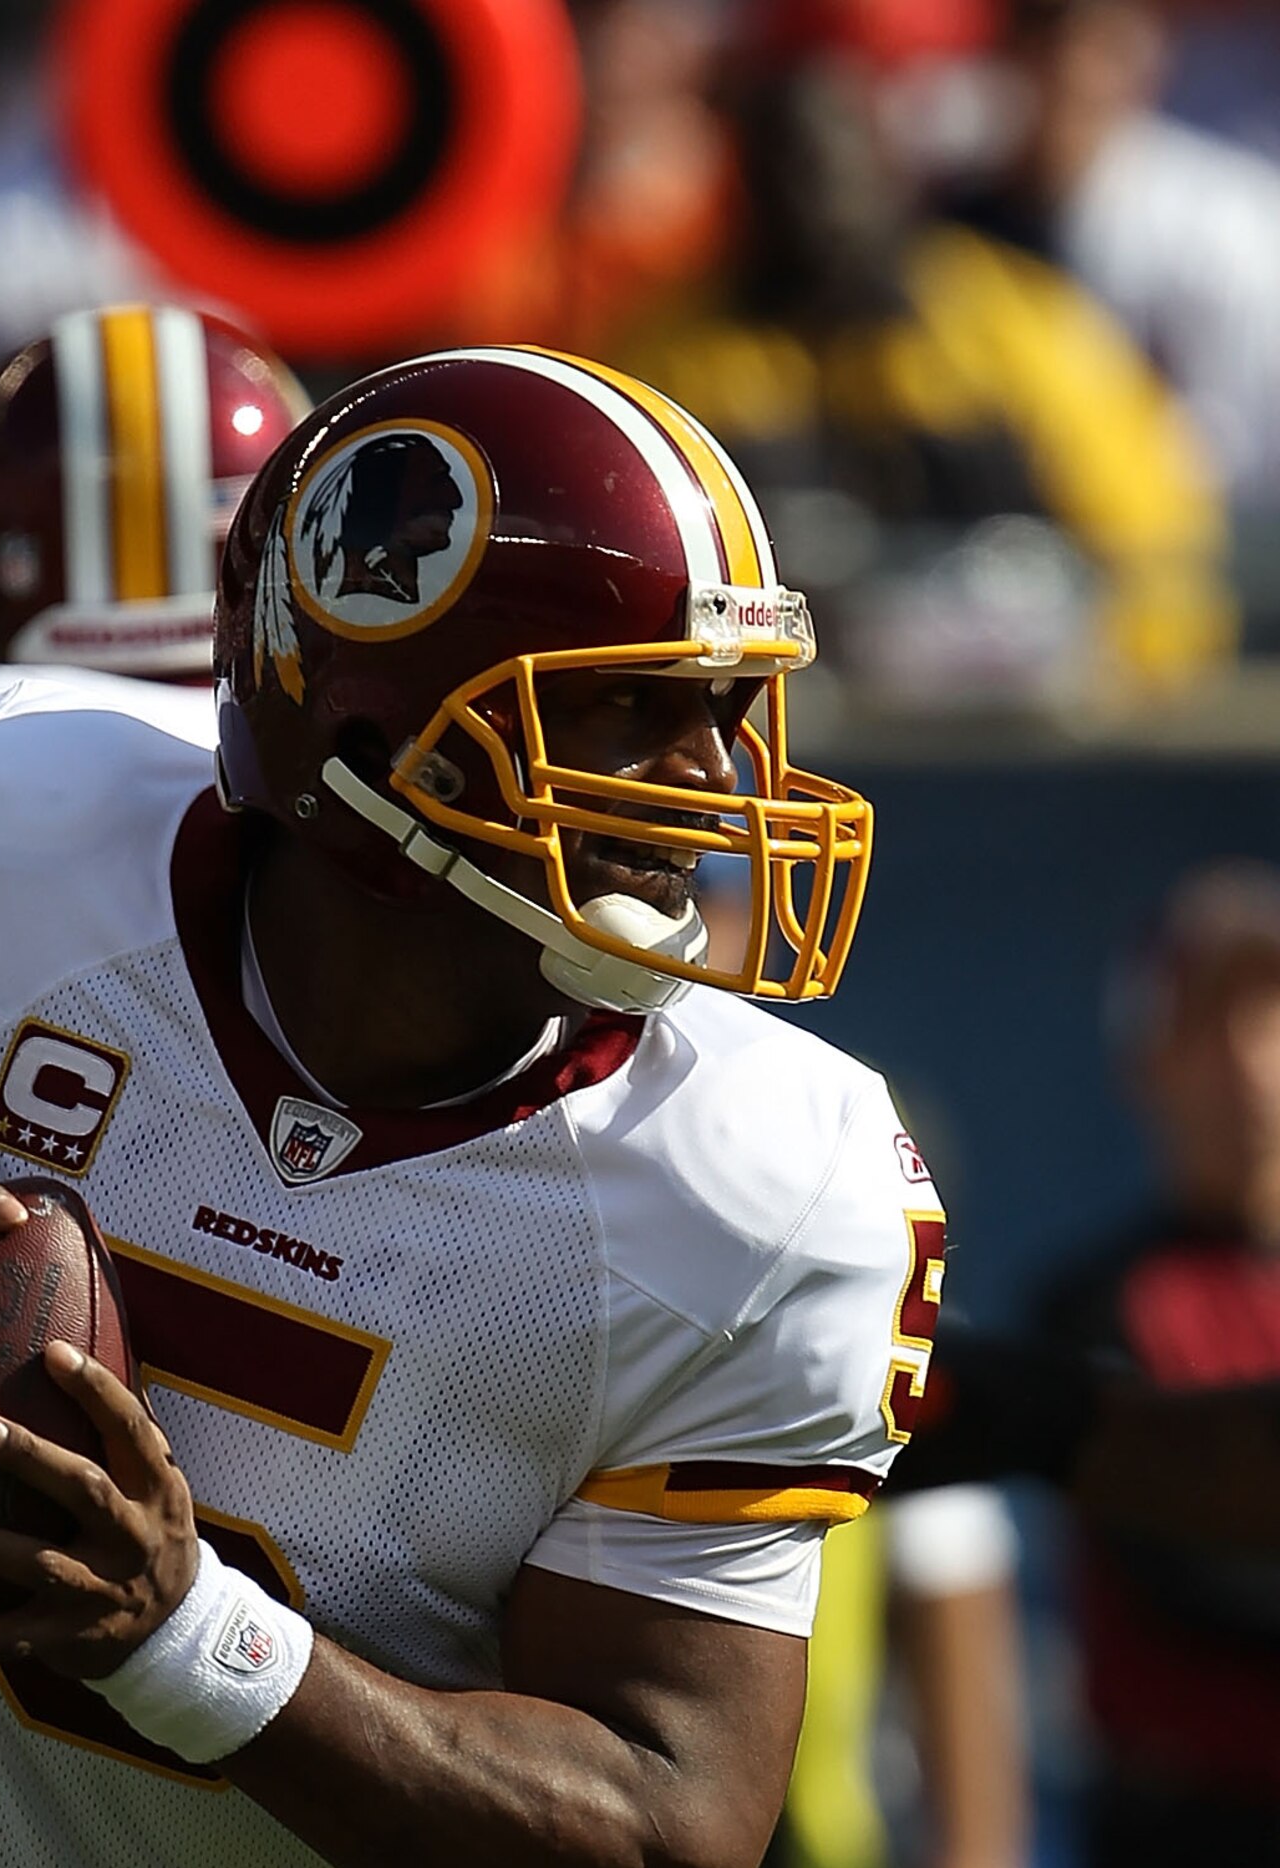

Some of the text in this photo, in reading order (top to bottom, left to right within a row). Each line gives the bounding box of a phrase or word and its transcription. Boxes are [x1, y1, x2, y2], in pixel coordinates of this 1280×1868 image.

[3, 1036, 116, 1137] C
[284, 1138, 318, 1168] NFL
[192, 1204, 345, 1283] REDSKINS
[247, 1631, 272, 1664] NFL
